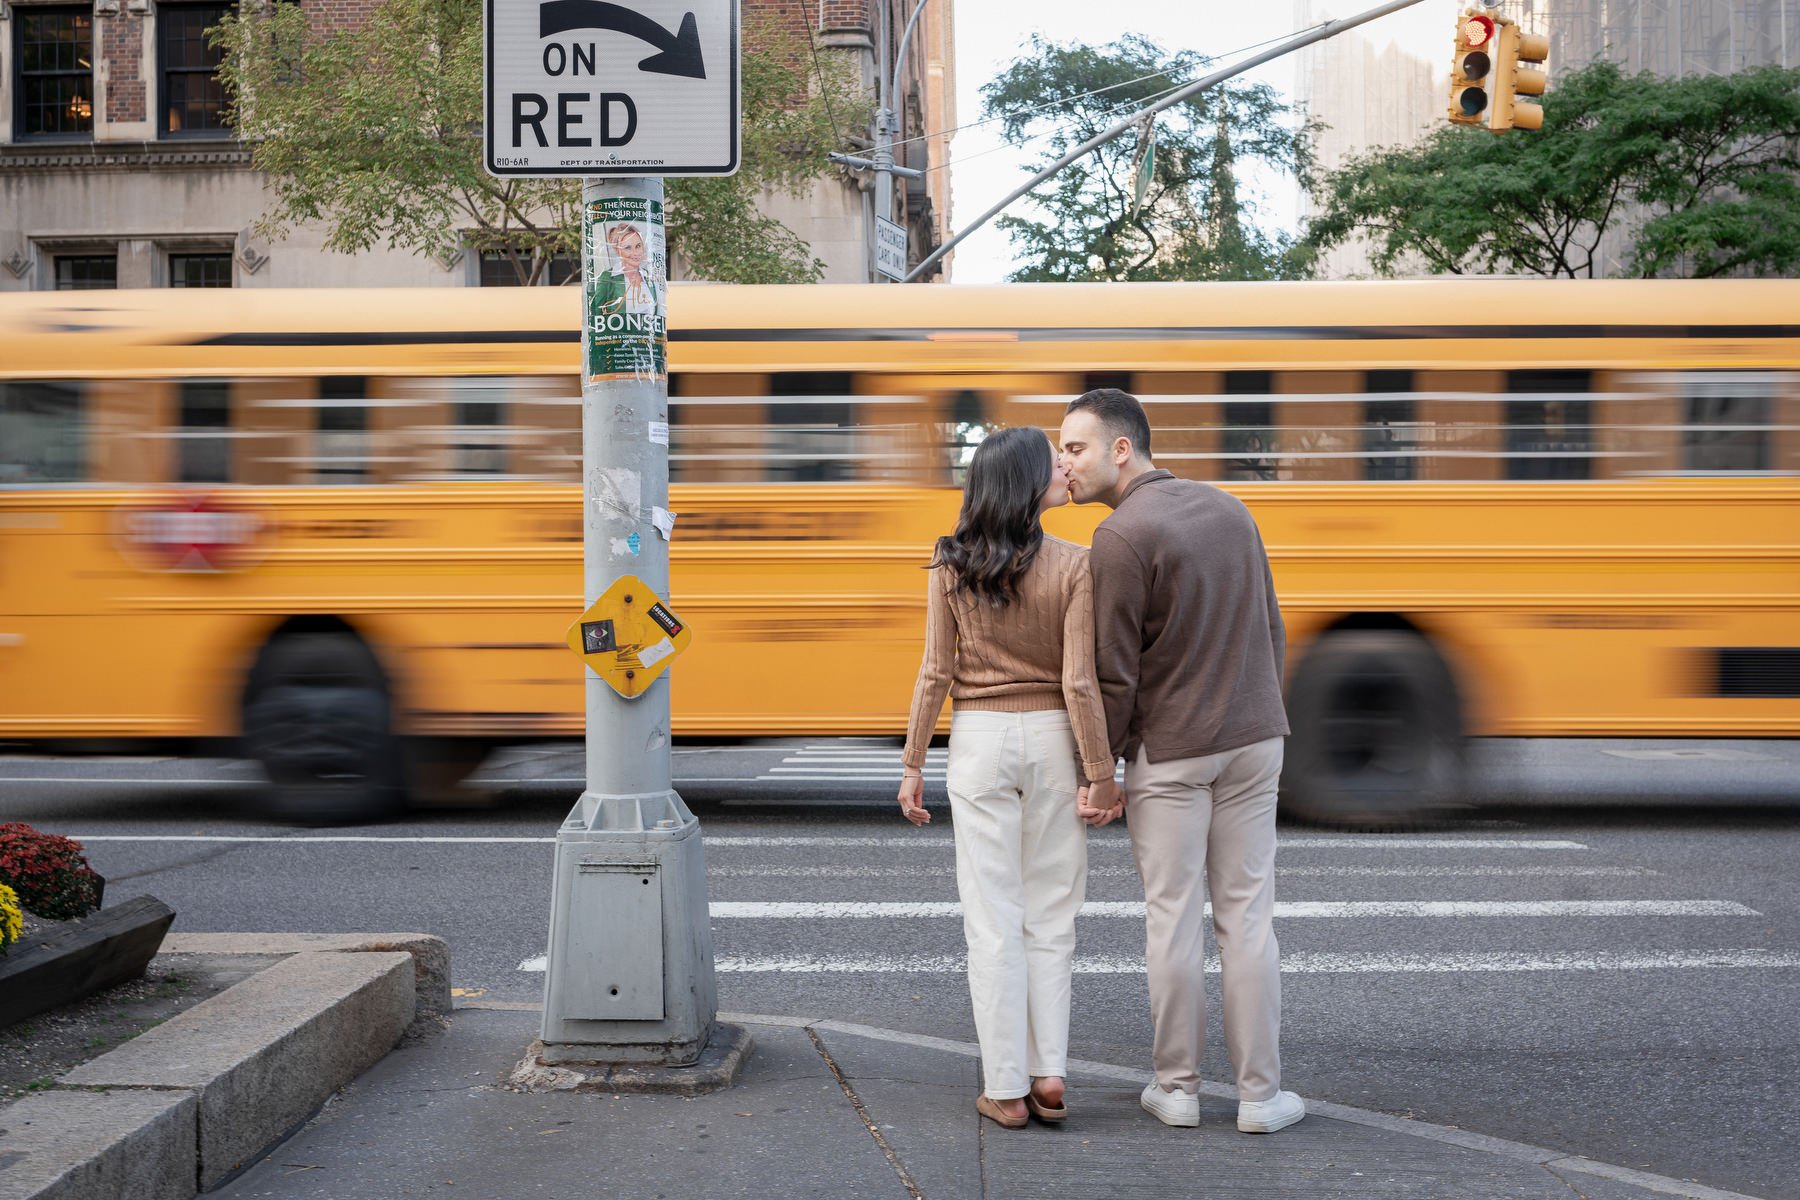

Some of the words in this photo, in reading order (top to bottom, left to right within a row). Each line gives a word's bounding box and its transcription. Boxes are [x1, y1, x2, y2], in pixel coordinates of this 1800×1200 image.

[543, 42, 596, 76] ON
[512, 92, 637, 148] RED
[604, 201, 618, 209] THE
[620, 201, 650, 209] NEGLEC
[878, 224, 905, 250] PASSENGER
[878, 245, 890, 264] CARS
[653, 606, 675, 627] LOCATIONS
